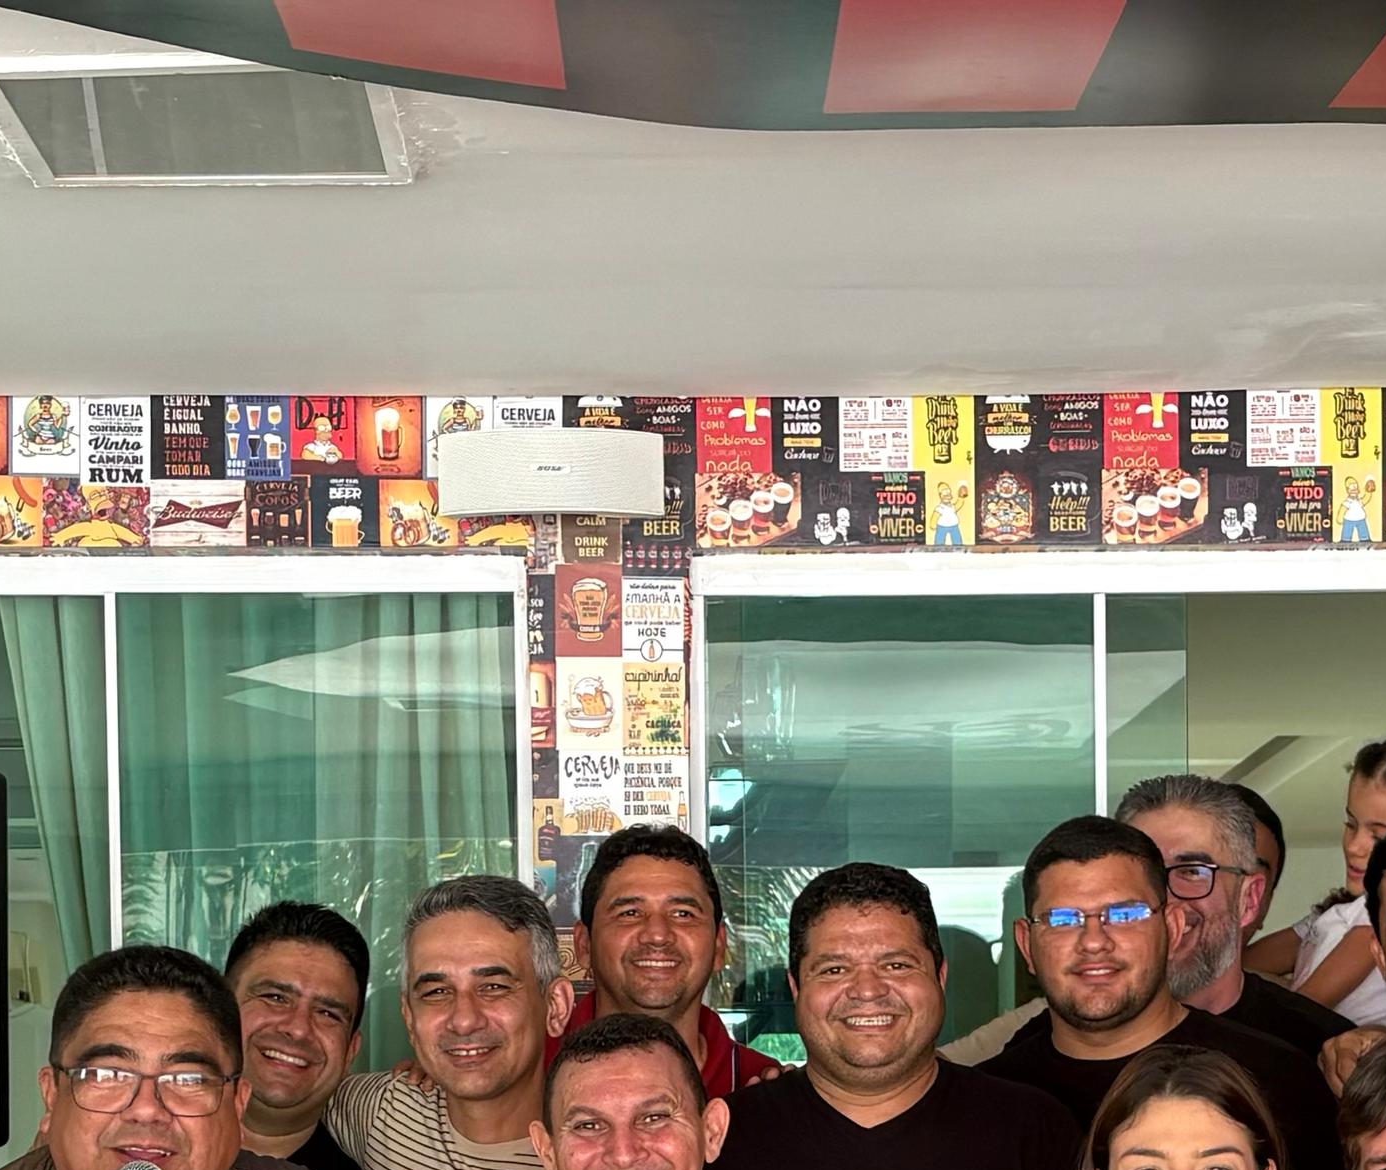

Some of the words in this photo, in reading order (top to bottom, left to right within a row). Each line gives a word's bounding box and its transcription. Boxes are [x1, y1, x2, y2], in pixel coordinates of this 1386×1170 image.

[783, 395, 821, 411] NÃO
[1190, 392, 1229, 408] NÃO
[88, 403, 143, 417] CERVEJA
[501, 407, 555, 422] CERVEJA
[1190, 417, 1229, 430] LUXO
[88, 468, 144, 484] RUM
[643, 520, 680, 536] BEER
[878, 518, 915, 537] VIVER
[1049, 516, 1088, 532] BEER
